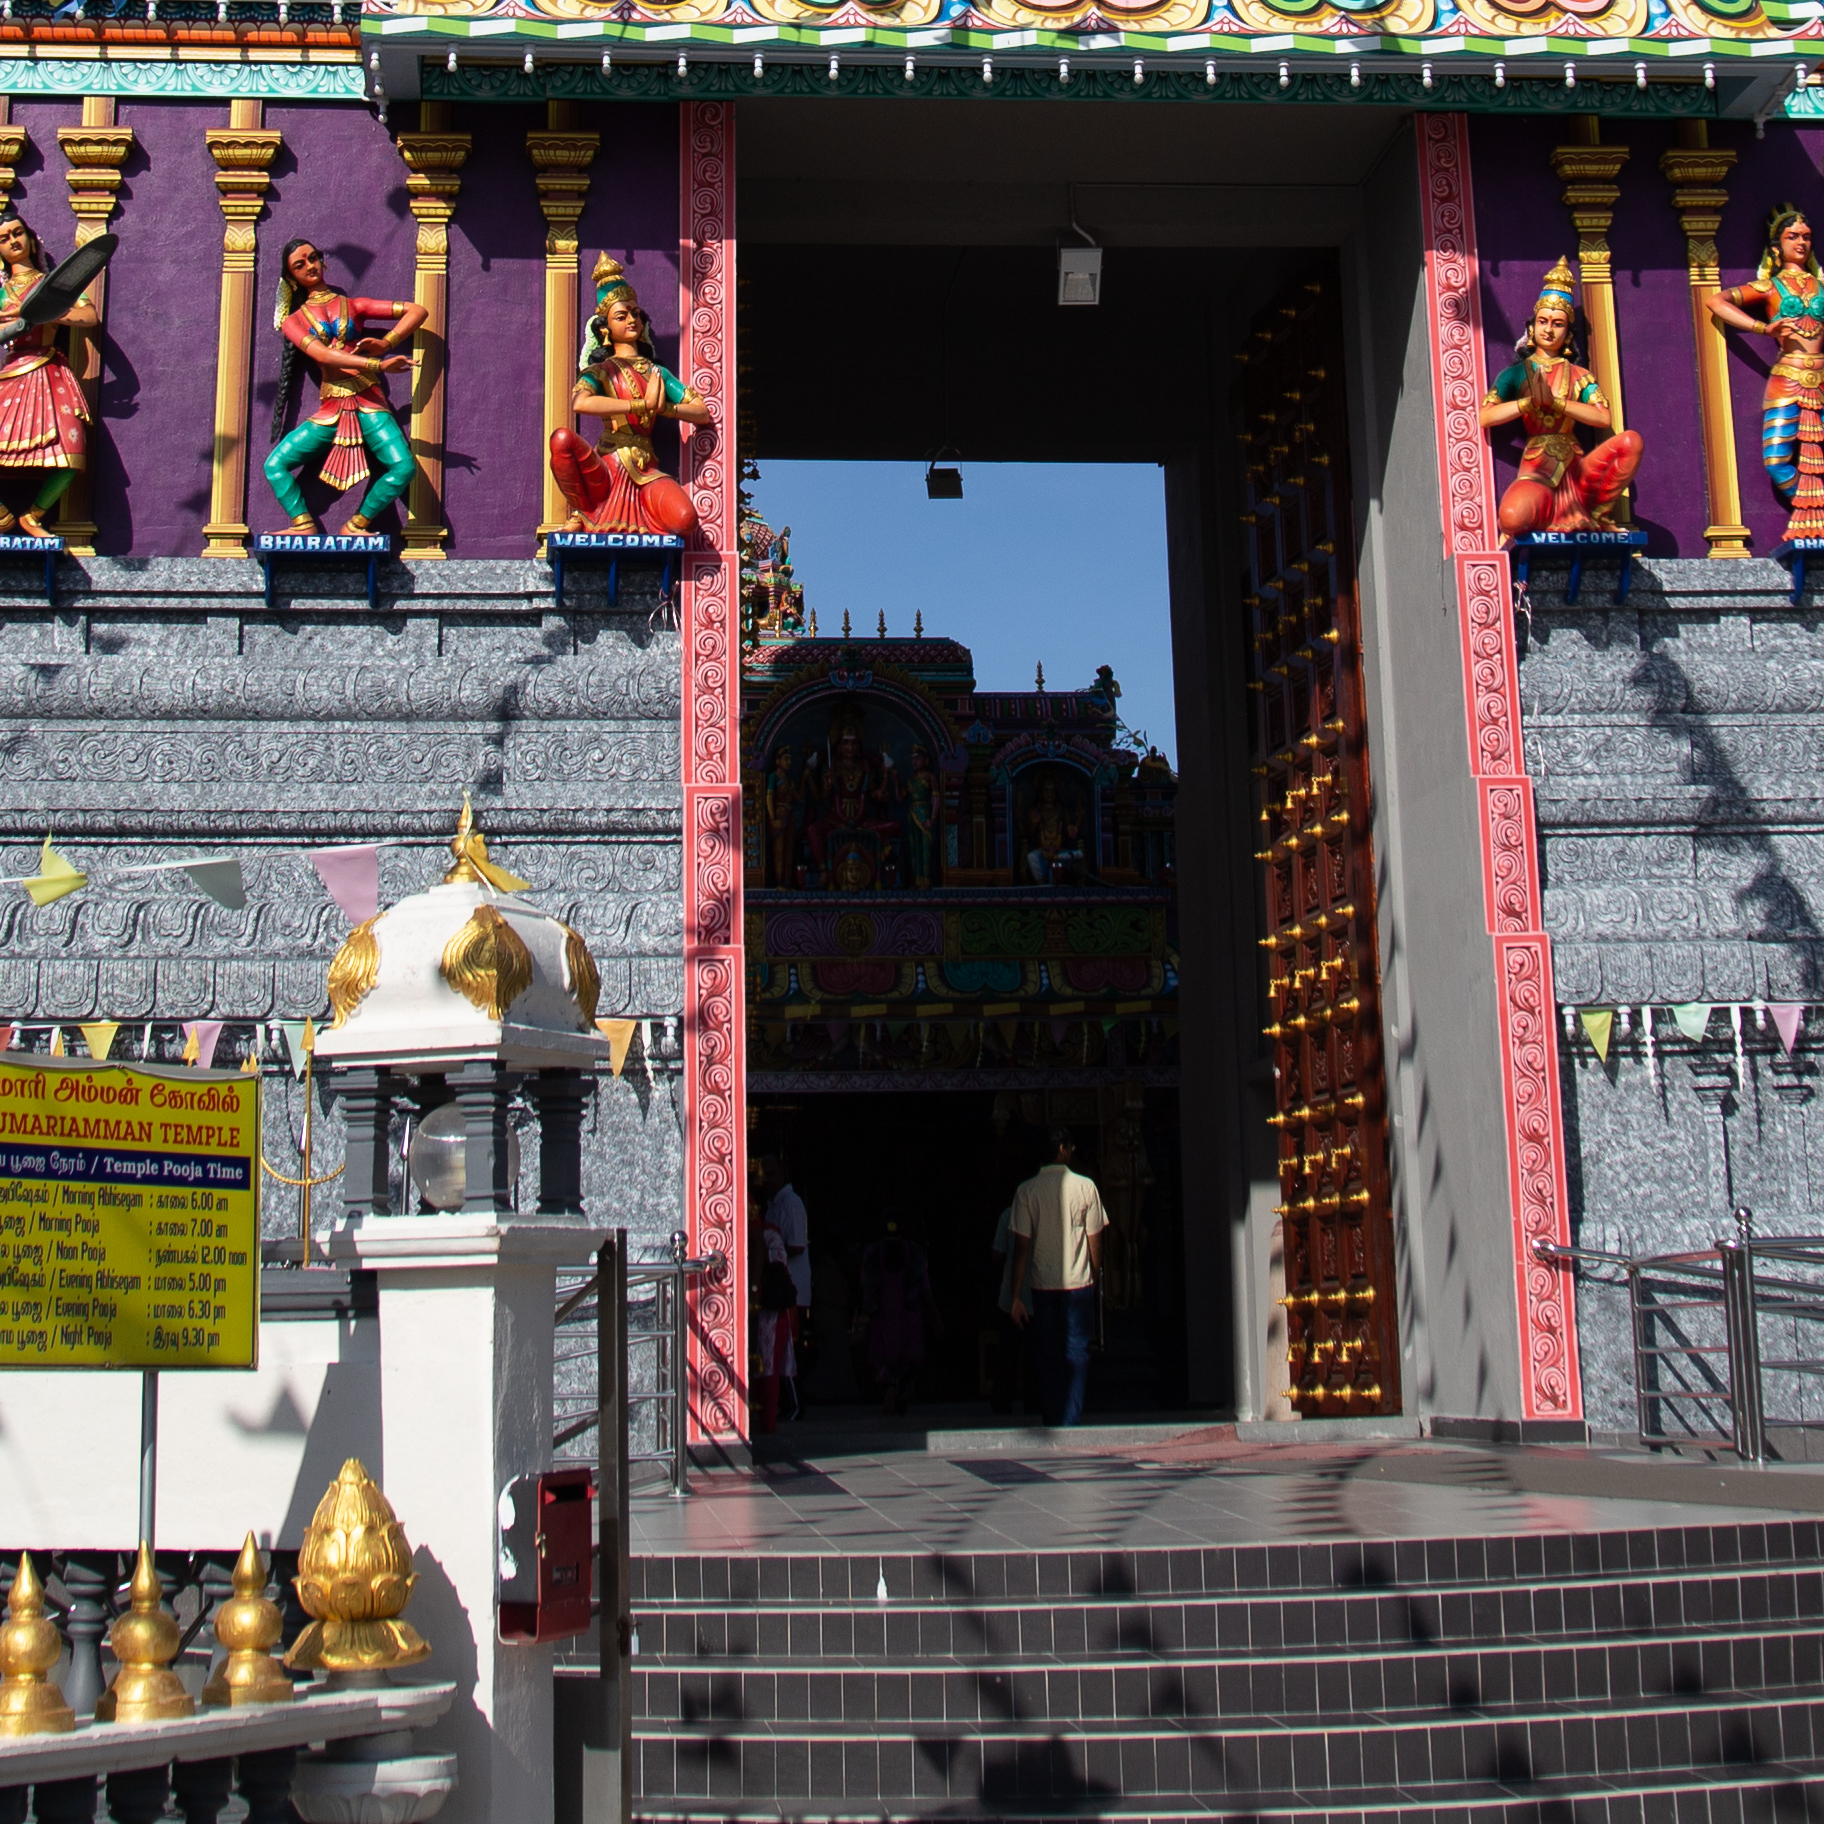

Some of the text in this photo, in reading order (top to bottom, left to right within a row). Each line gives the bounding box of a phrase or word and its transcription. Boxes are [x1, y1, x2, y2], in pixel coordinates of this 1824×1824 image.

[258, 535, 386, 551] BHARATAM
[555, 532, 678, 548] WELCOME
[1532, 532, 1629, 545] WELCOME
[54, 1073, 142, 1106] அம்மன்
[150, 1080, 240, 1113] கோவில்
[160, 1123, 239, 1147] TEMPLE
[11, 1155, 45, 1172] பூஜை
[50, 1151, 85, 1175] நேரம்
[104, 1157, 158, 1178] Temple
[164, 1161, 202, 1181] Pooja
[207, 1163, 242, 1179] Time
[62, 1185, 95, 1210] Morning
[157, 1195, 187, 1209] காலை
[192, 1192, 213, 1210] 6.00
[39, 1211, 71, 1237] Morning
[75, 1213, 99, 1238] Pooja
[191, 1218, 212, 1237] 7.00
[11, 1244, 43, 1267] பூஜை
[82, 1241, 105, 1266] Pooja
[202, 1246, 225, 1264] 12.00
[189, 1273, 211, 1291] 5.00
[92, 1297, 210, 1322] Pooja 6.30
[87, 1325, 204, 1350] Pooja 9.30
